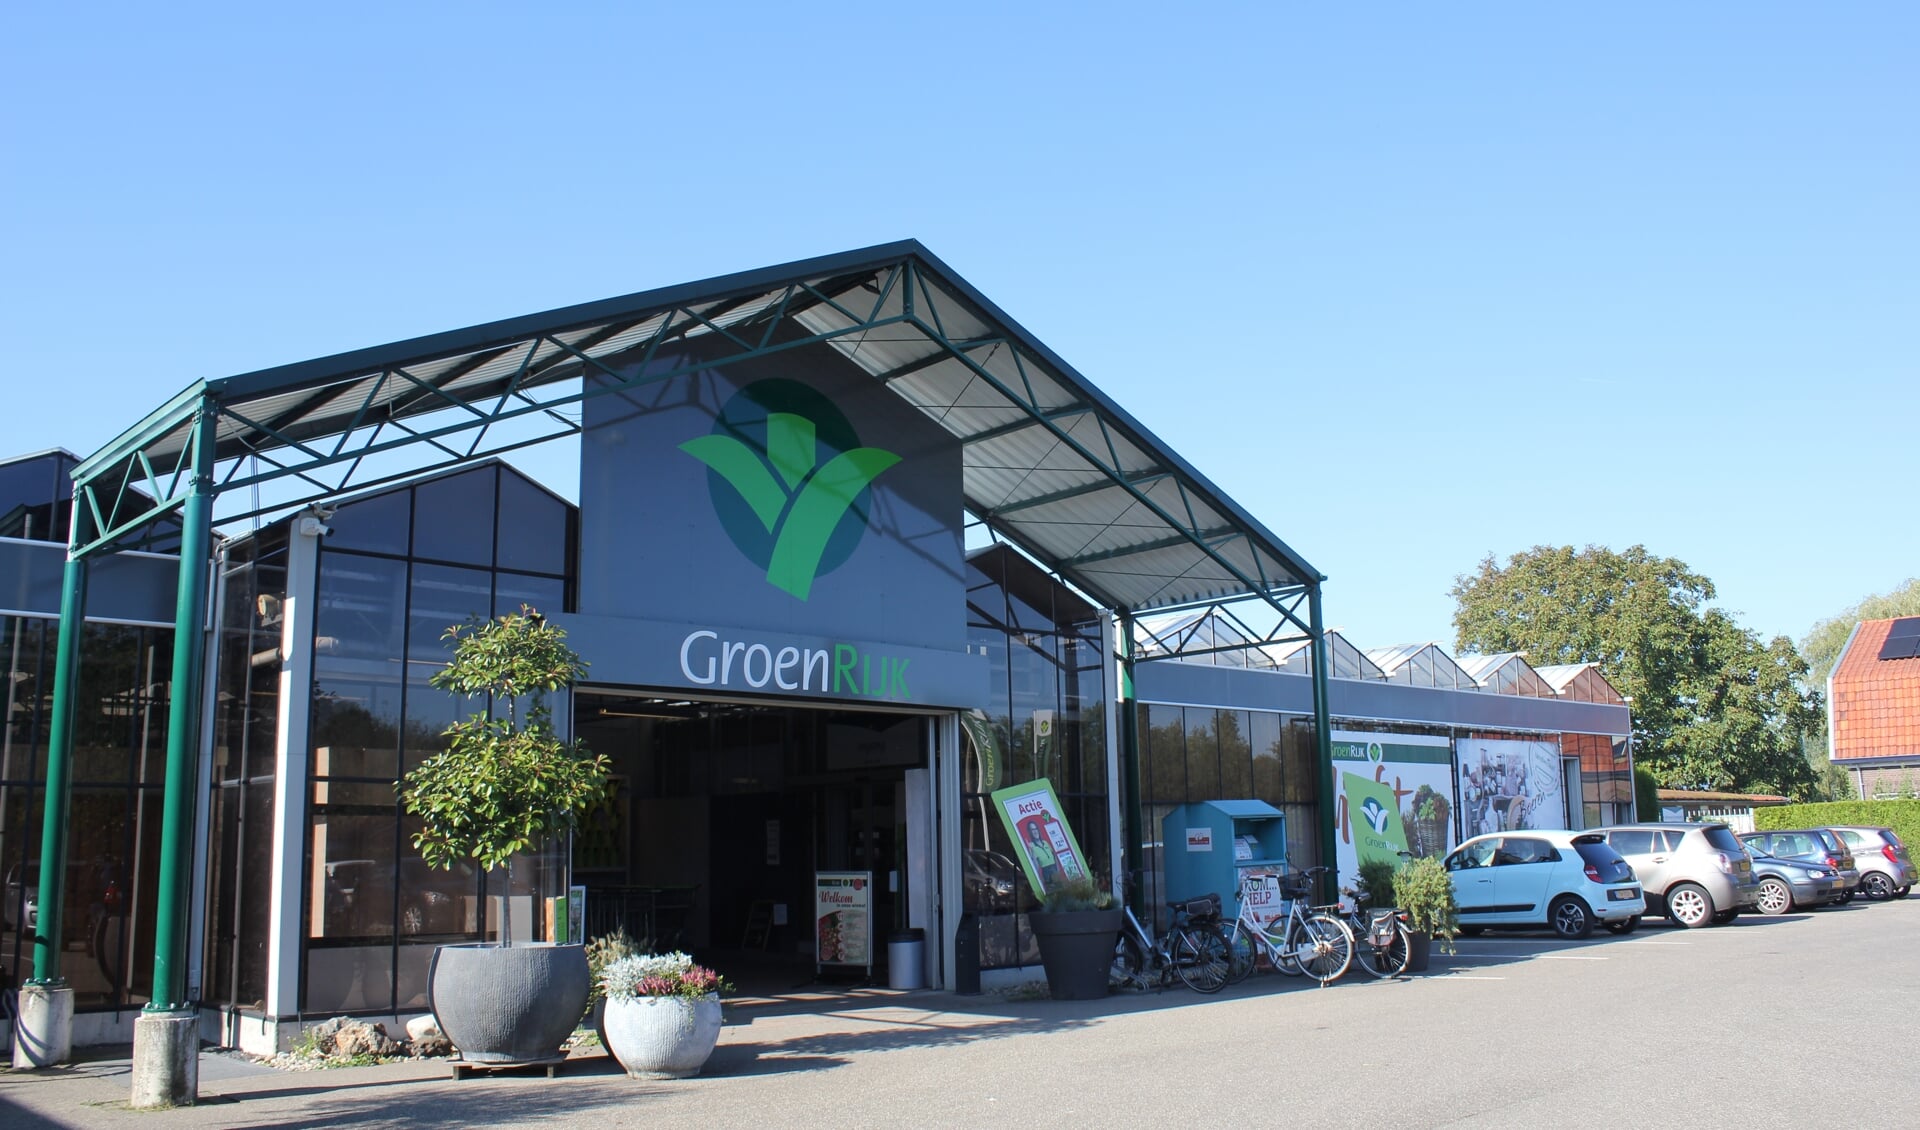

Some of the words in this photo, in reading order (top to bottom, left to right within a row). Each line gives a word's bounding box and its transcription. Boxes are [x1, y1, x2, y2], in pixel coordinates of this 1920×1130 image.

[1331, 744, 1365, 758] roenRIJK
[1018, 800, 1043, 815] Actie
[819, 890, 853, 904] Welkom
